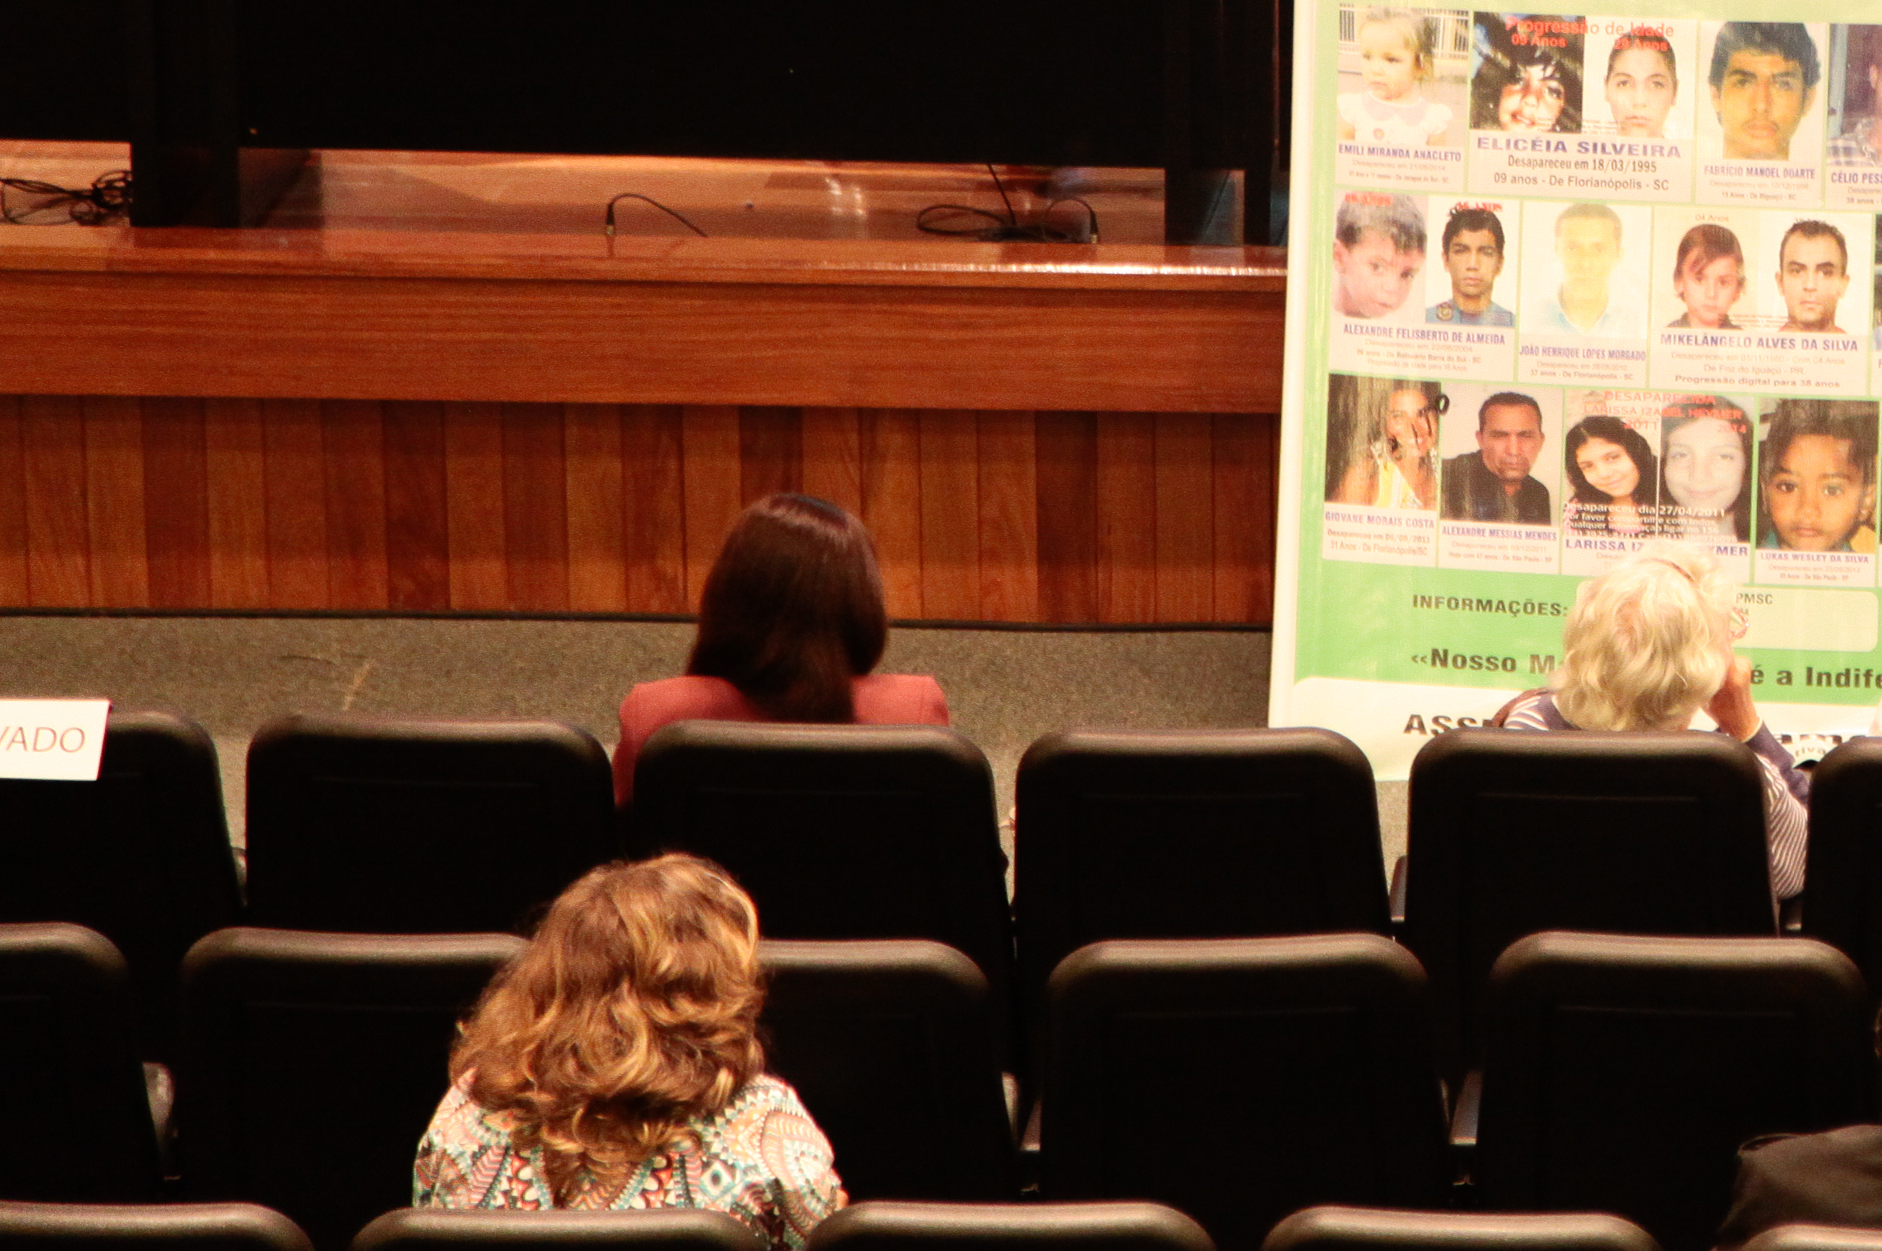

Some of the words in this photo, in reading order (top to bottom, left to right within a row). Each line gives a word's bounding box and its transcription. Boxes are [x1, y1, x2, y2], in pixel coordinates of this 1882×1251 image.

[1505, 16, 1599, 36] Progressão
[1605, 22, 1624, 35] de
[1631, 22, 1674, 37] Idade
[1531, 35, 1567, 47] Anos
[1338, 144, 1365, 156] EMILI
[1367, 147, 1411, 160] MIRANDA
[1414, 150, 1461, 162] ANACLETO
[1477, 135, 1568, 154] ELICÉIA
[1577, 141, 1682, 158] SILVEIRA
[1508, 155, 1572, 171] Desapareceu
[1575, 160, 1589, 170] em
[1592, 159, 1657, 173] 18/03/1995
[1494, 172, 1507, 184] 09
[1510, 176, 1538, 186] anos
[1549, 175, 1565, 186] De
[1568, 175, 1643, 191] Florianópolis
[1653, 179, 1669, 191] SC
[1831, 168, 1859, 184] CÉLIO
[1344, 324, 1393, 339] ALEXANDRE
[1397, 328, 1449, 342] FELISBERTO
[1452, 332, 1463, 342] DE
[1466, 333, 1506, 345] ALMEIDA
[1660, 332, 1751, 348] MIKELÂNGELO
[1757, 337, 1796, 349] ALVES
[1801, 338, 1817, 350] DA
[1823, 339, 1858, 351] SILVA
[1367, 515, 1402, 527] MORAIS
[1405, 517, 1435, 529] COSTA
[1565, 539, 1626, 552] LARISSA
[1776, 670, 1793, 686] a
